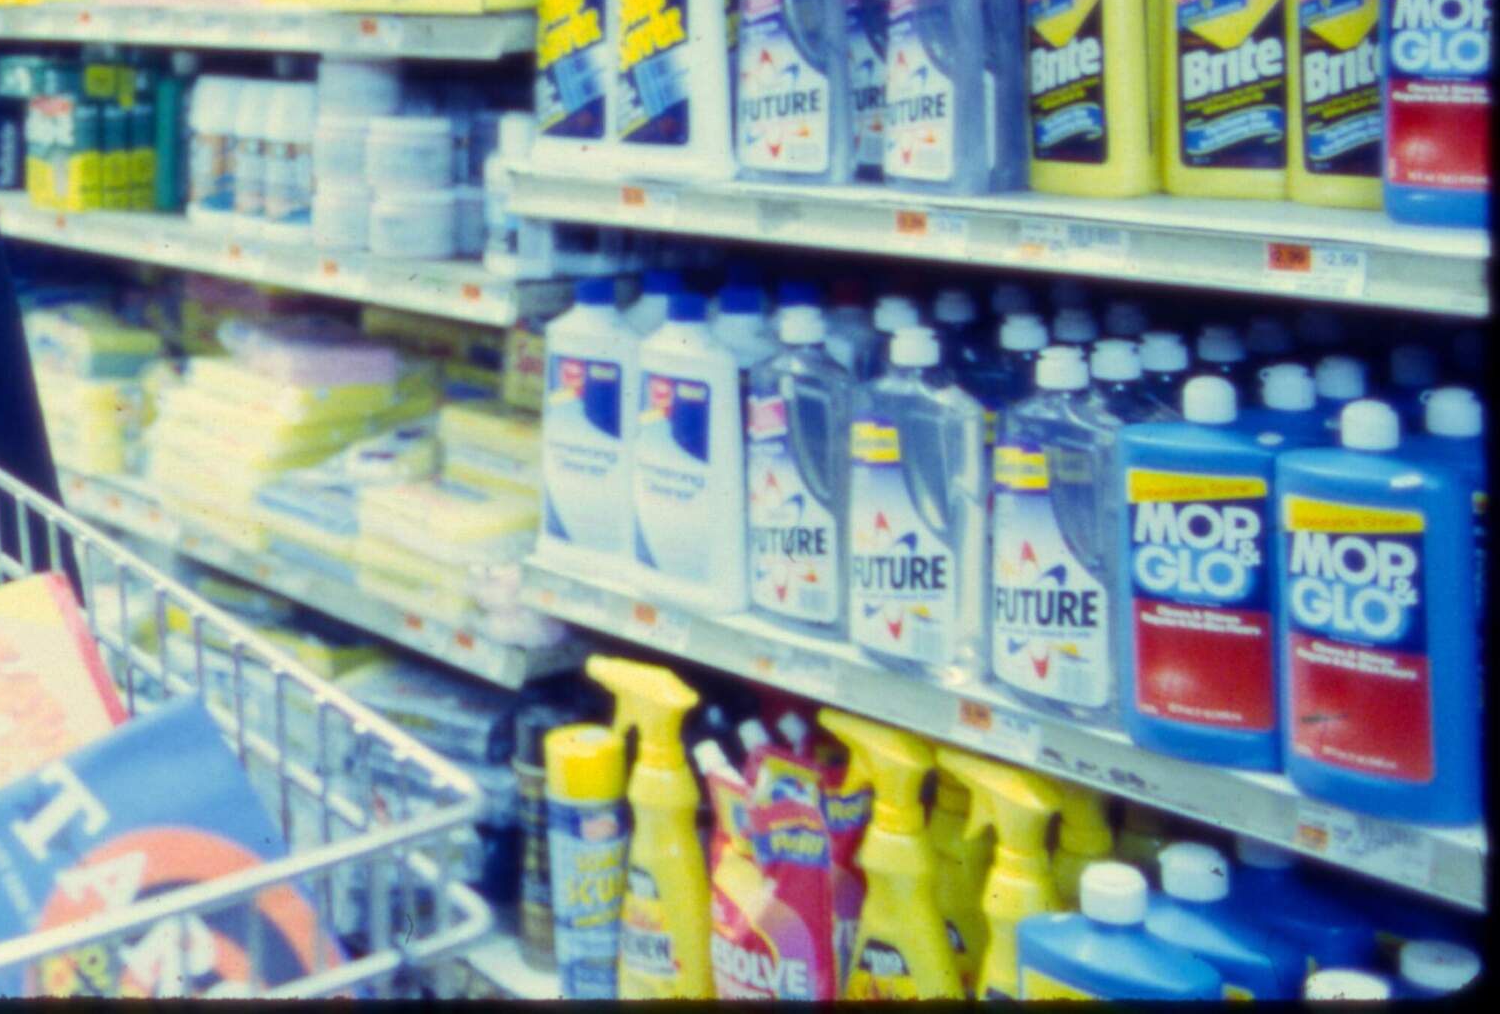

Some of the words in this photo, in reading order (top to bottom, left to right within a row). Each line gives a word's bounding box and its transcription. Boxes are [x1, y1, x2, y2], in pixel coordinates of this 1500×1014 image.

[1031, 37, 1102, 95] Brite
[1182, 37, 1283, 102] Brite
[1392, 30, 1490, 73] GLO
[1133, 500, 1261, 551] MOP
[852, 553, 948, 593] FUTURE
[1134, 545, 1247, 598] GLO
[1289, 527, 1419, 588] MOP
[996, 585, 1100, 629] FUTURE
[1291, 576, 1402, 637] GLO
